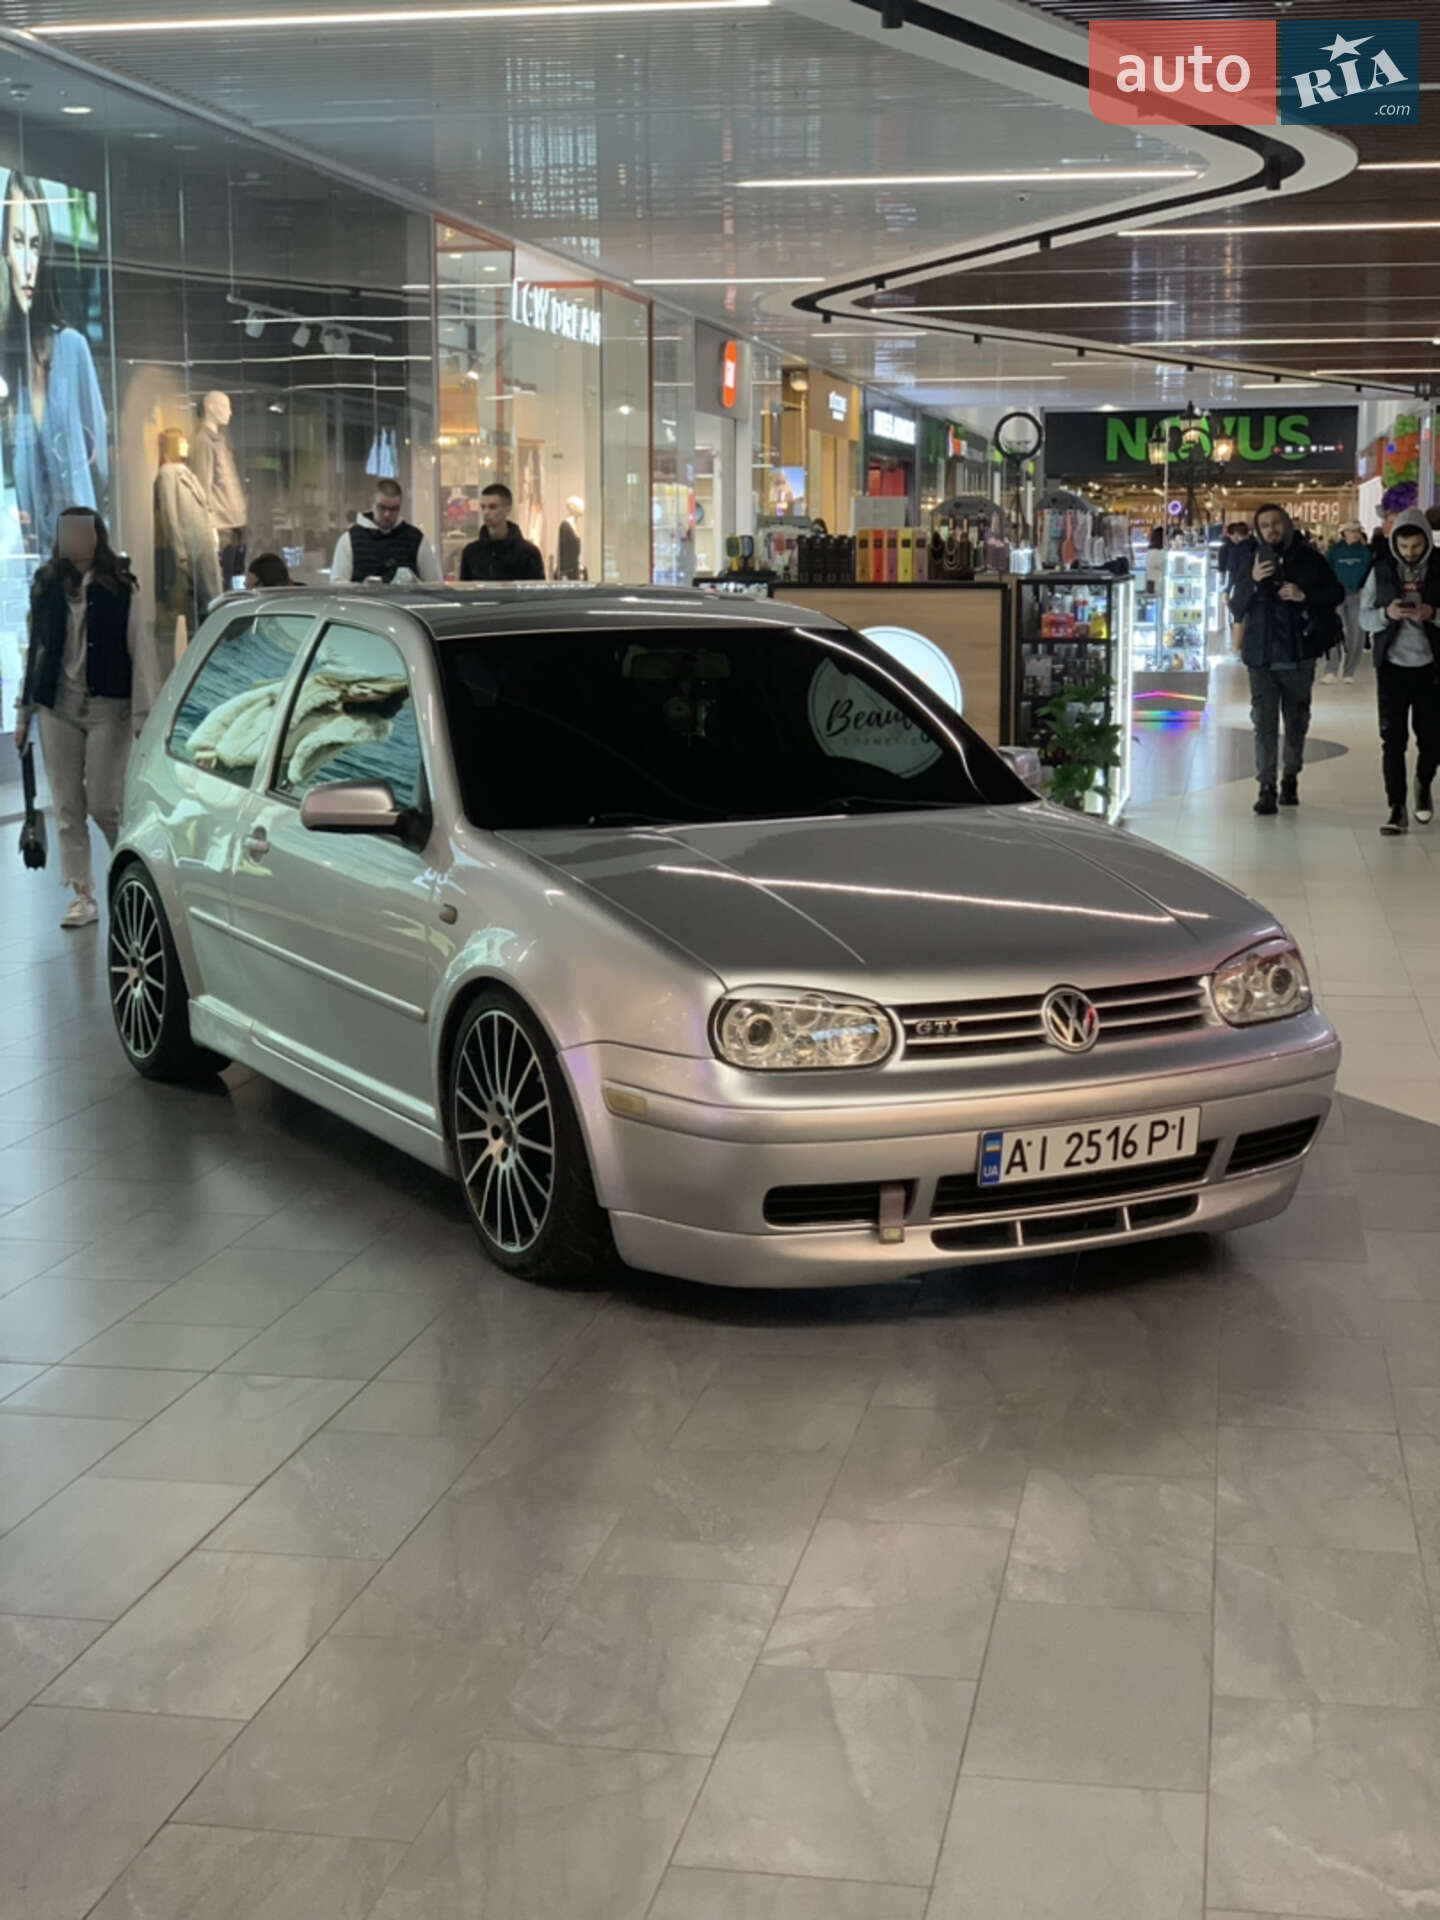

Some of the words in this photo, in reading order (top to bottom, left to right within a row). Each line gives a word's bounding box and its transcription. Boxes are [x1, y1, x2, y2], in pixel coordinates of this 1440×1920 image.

[825, 699, 931, 744] Beau
[1004, 1135, 1048, 1176] AI
[1063, 1122, 1139, 1169] 2516
[1146, 1115, 1186, 1157] PI
[983, 1165, 999, 1177] UA
